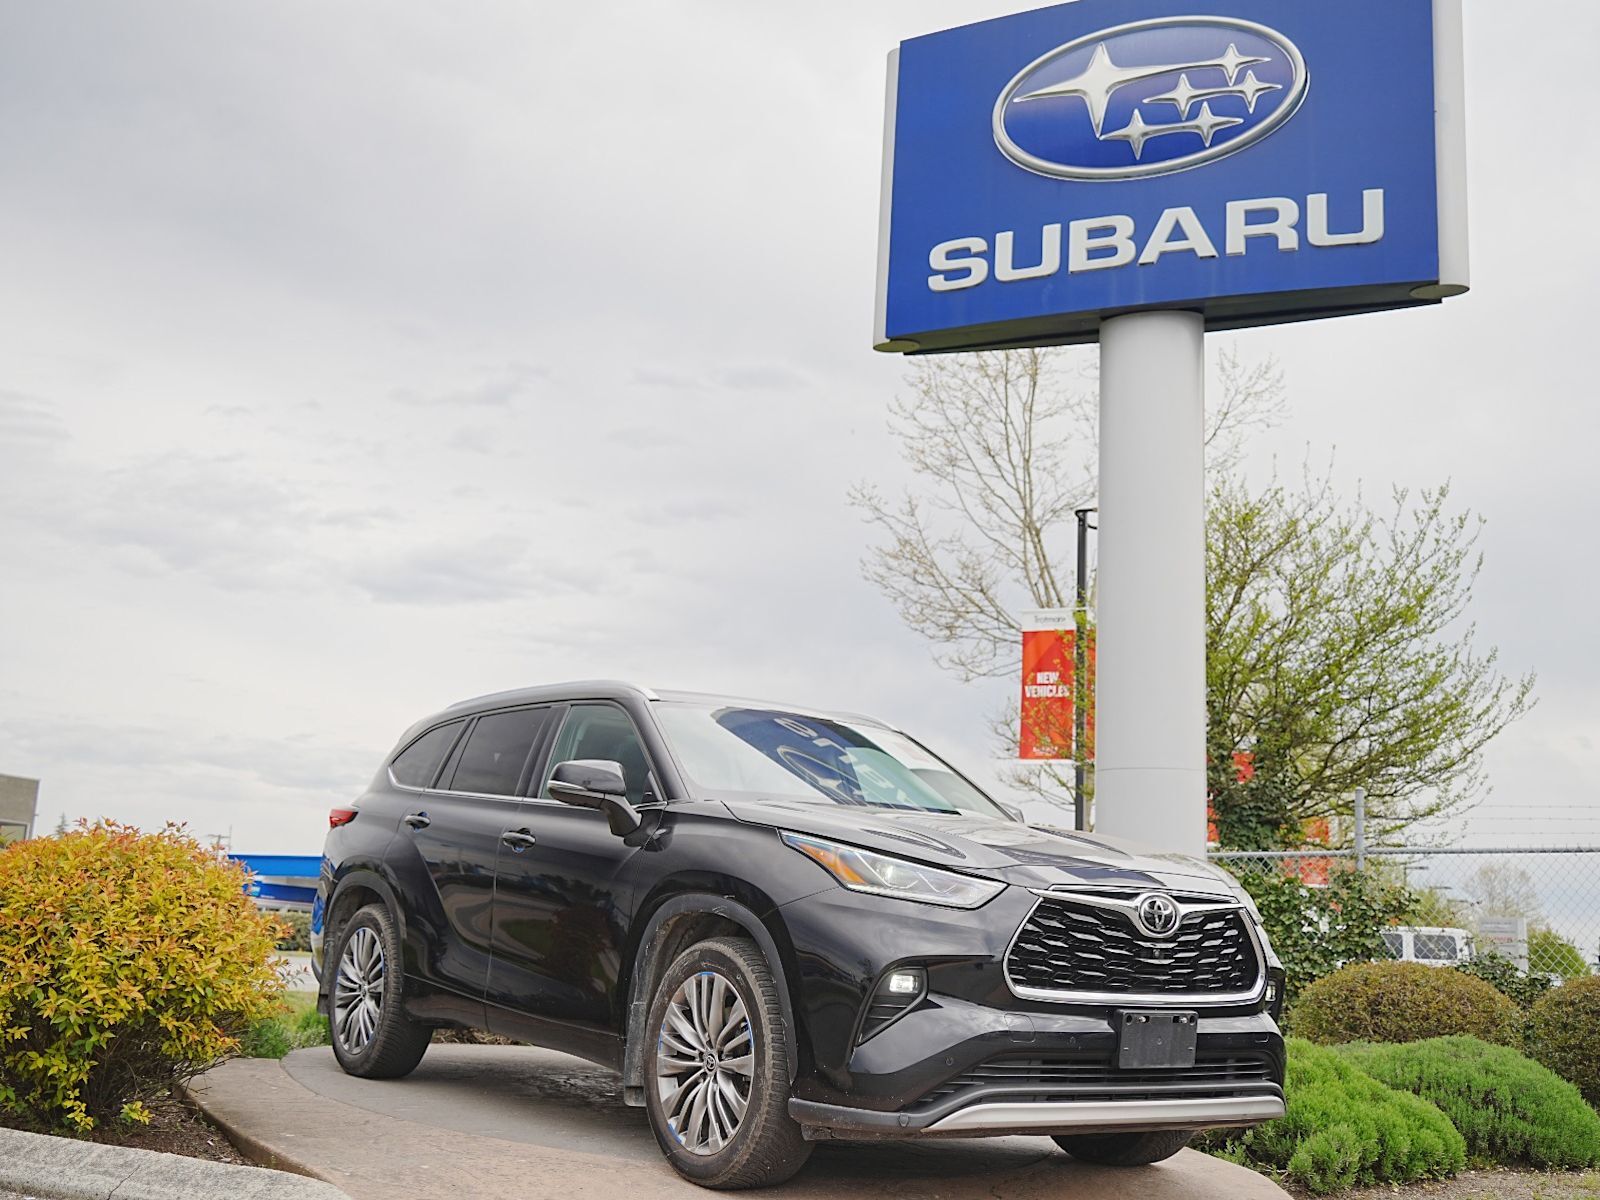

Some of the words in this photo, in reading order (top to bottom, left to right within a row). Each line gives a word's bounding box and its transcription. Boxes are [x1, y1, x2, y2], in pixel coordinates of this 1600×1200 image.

[927, 188, 1385, 292] SUBARU
[1036, 671, 1060, 685] NEW
[1024, 685, 1070, 698] VEHICLES
